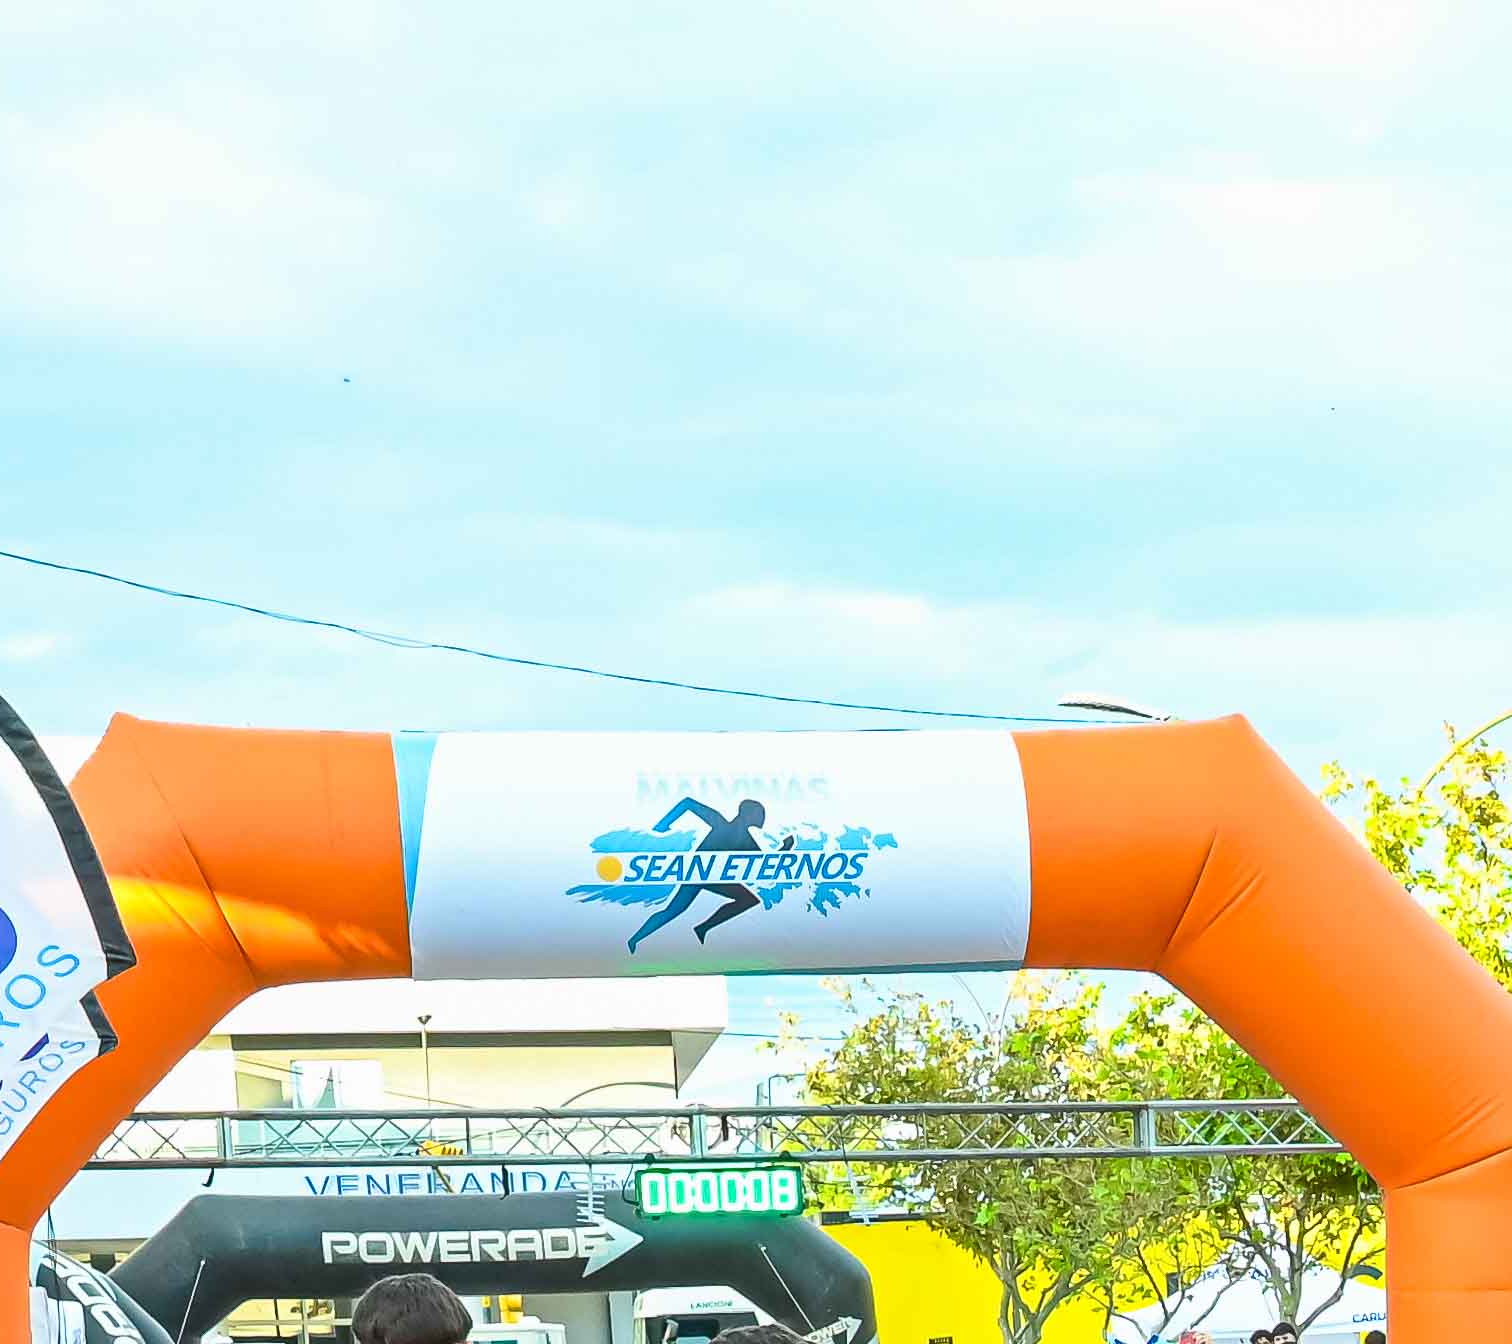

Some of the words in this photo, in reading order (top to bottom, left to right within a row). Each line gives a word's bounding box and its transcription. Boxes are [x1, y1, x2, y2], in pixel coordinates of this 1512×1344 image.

[624, 853, 716, 882] SEAN
[719, 852, 869, 881] ETERNOS
[321, 1226, 612, 1265] POWERADE
[1352, 1312, 1386, 1323] CARU
